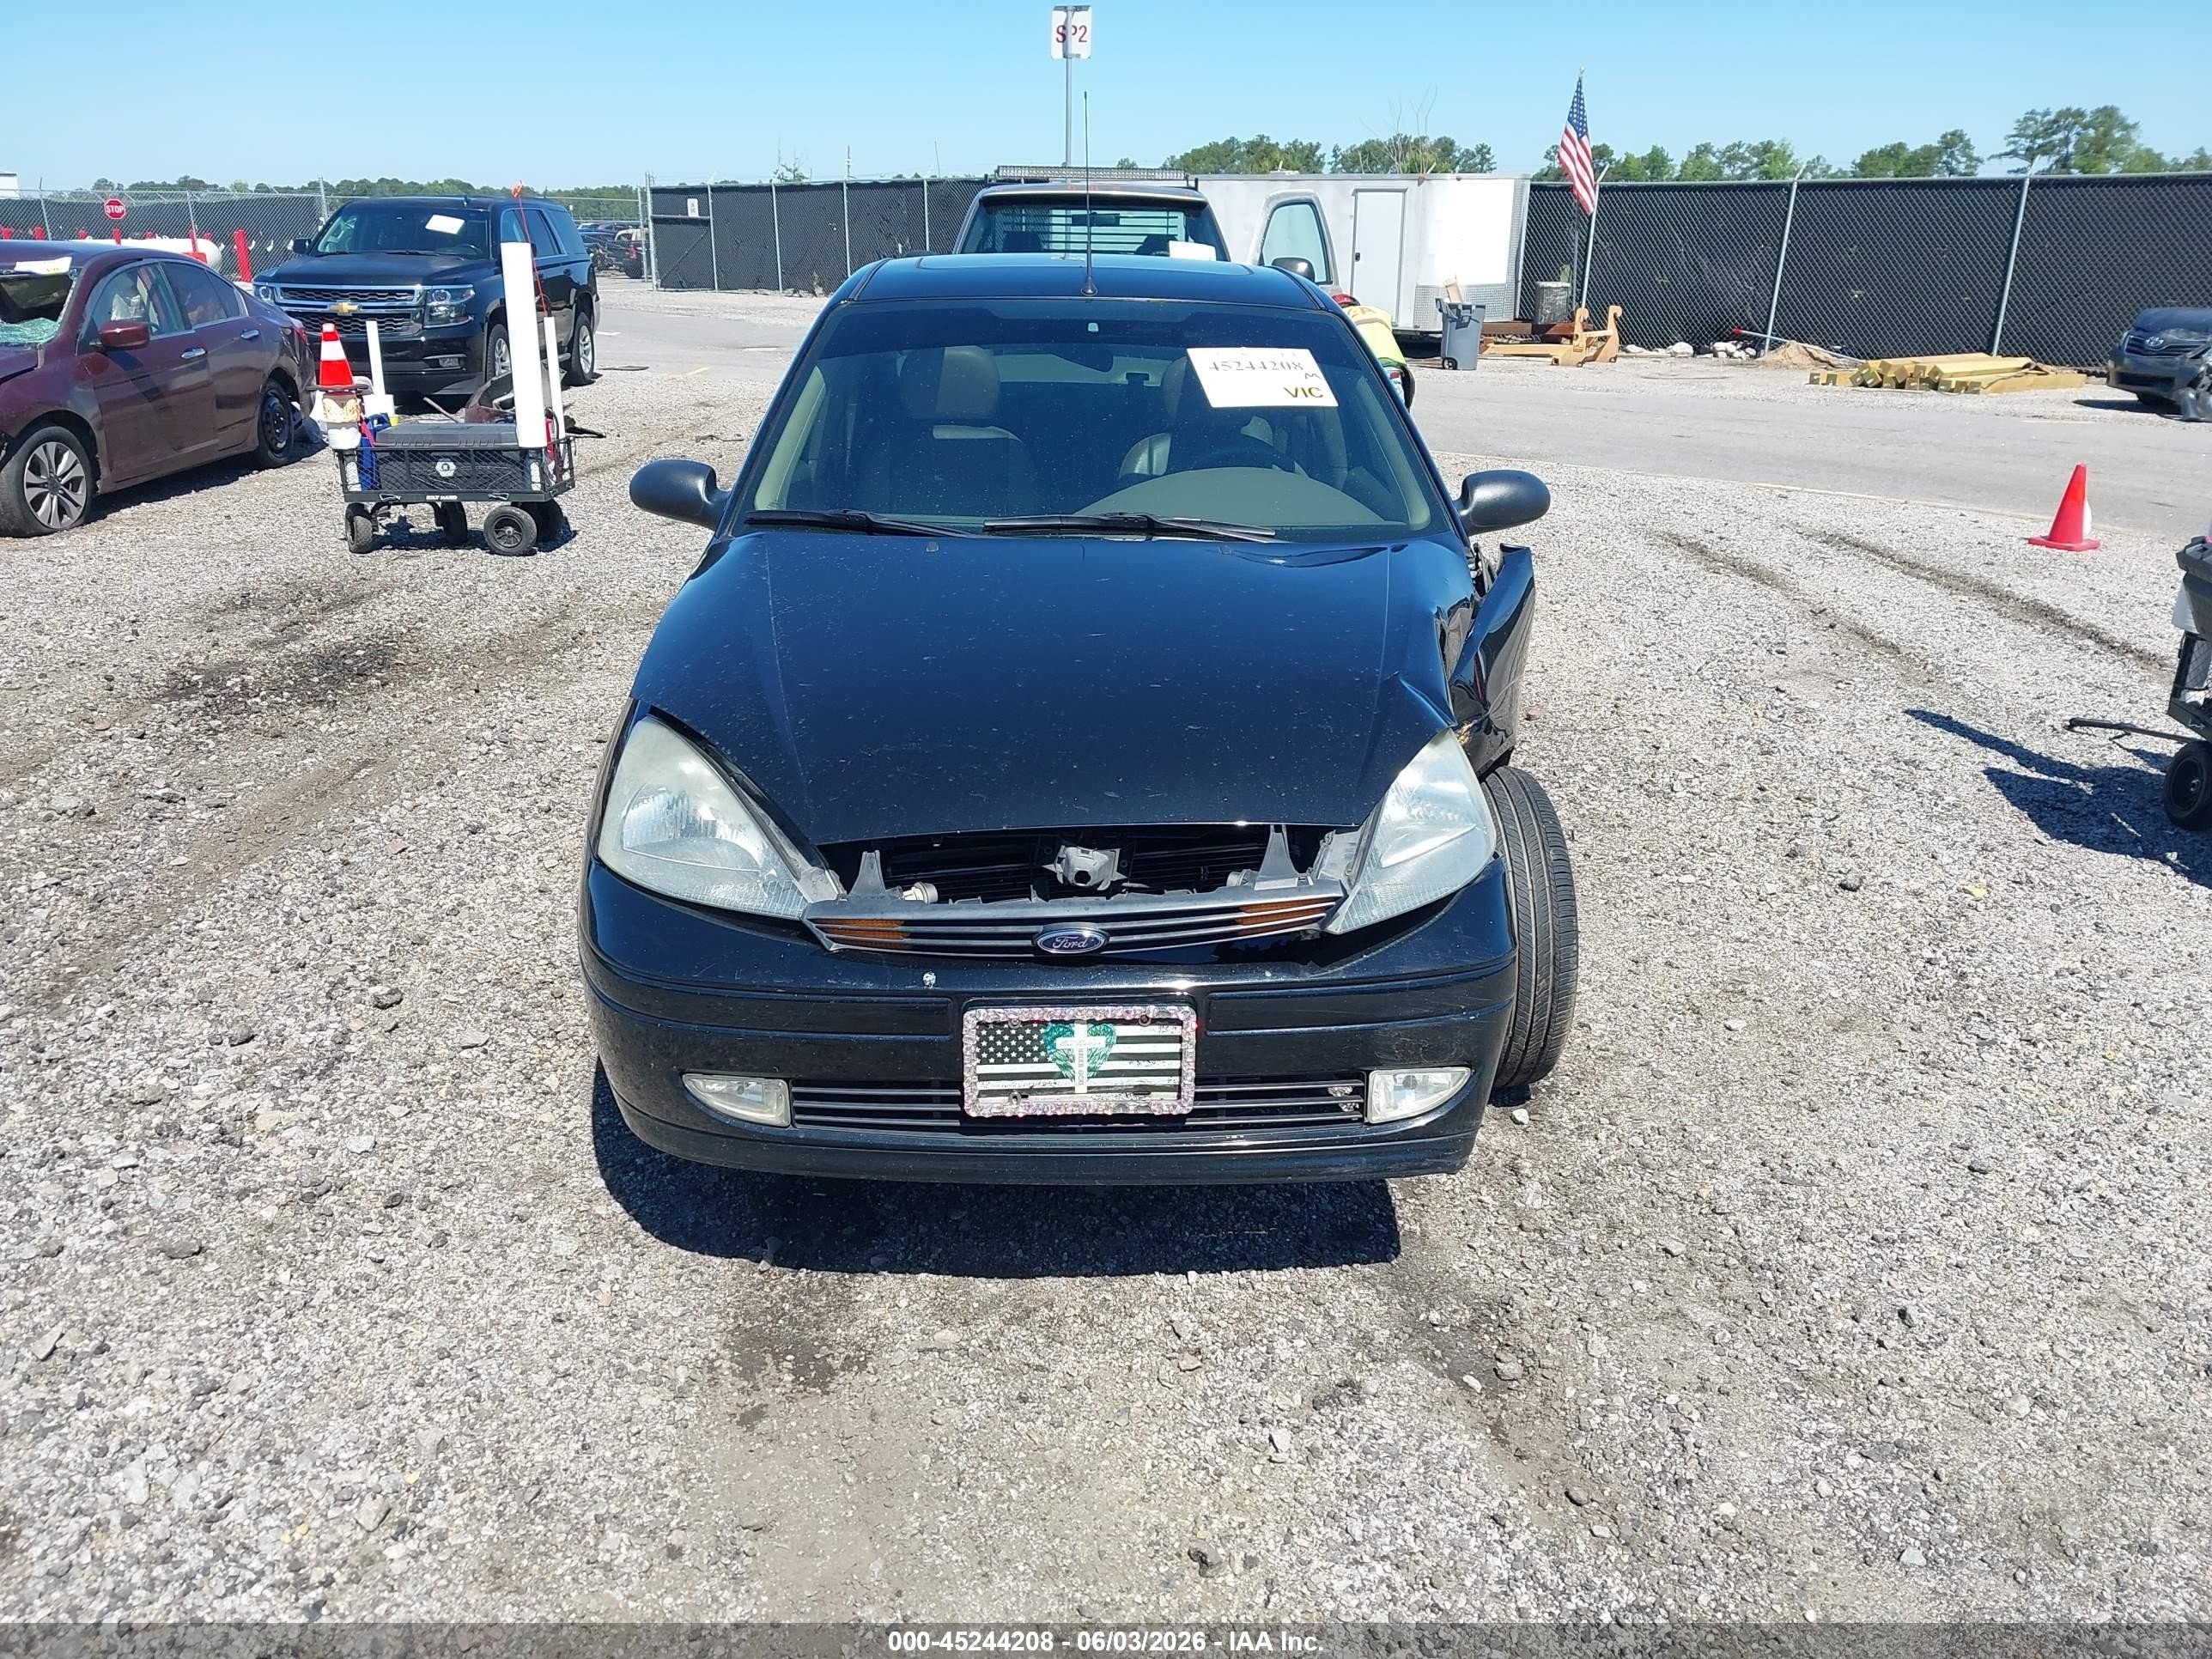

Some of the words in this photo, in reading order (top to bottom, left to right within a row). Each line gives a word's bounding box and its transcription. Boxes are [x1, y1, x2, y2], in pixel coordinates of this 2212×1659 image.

[106, 205, 124, 214] STOP
[1283, 386, 1324, 398] VIC
[1053, 935, 1088, 949] Ford
